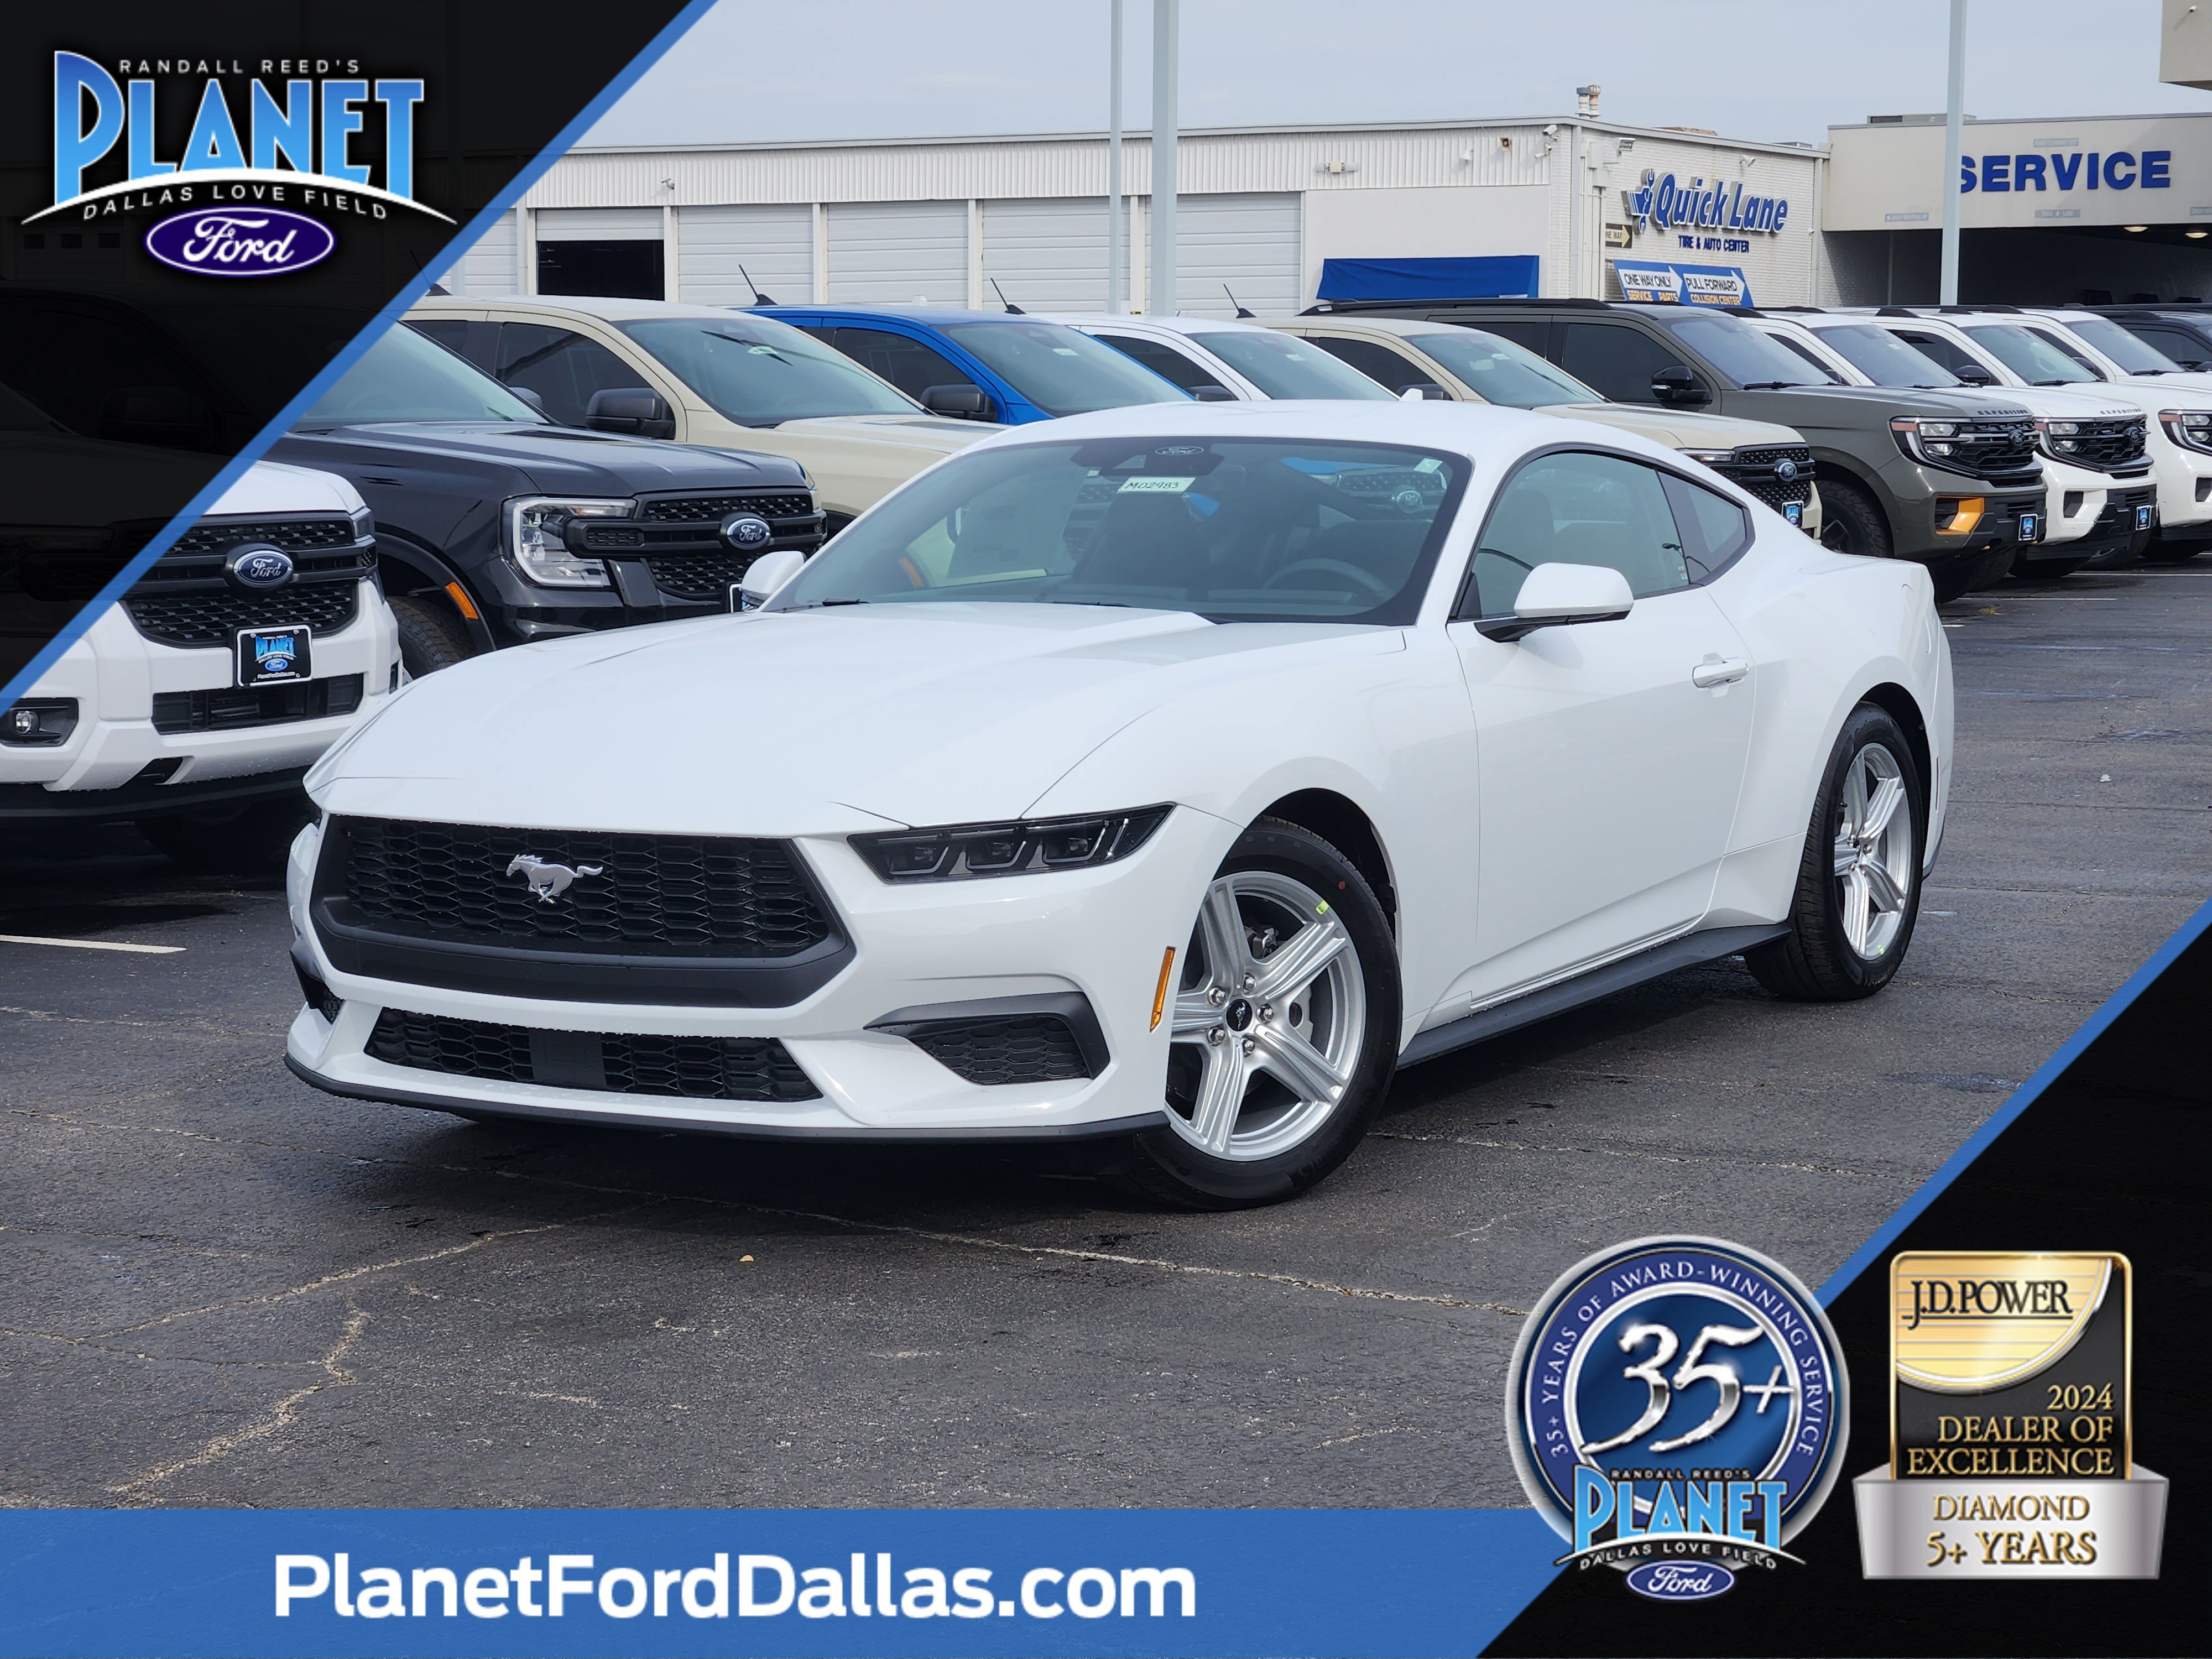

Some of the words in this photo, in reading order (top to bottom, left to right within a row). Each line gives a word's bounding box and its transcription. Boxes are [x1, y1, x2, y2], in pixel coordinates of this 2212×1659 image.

[1655, 172, 1730, 230] Quick
[1728, 181, 1789, 233] Lane
[1678, 234, 1694, 248] TIRE
[1696, 236, 1701, 249] &
[1703, 237, 1721, 251] AUTO
[1723, 238, 1749, 253] CENTER
[1624, 273, 1640, 285] ONE
[1638, 274, 1655, 286] WAY
[1654, 275, 1672, 288] ONLY
[1686, 278, 1705, 289] PULL
[1704, 278, 1738, 291] FORWARD
[1627, 290, 1653, 301] SERVICE
[1658, 291, 1679, 302] PARTS
[1691, 293, 1719, 304] COLLISION
[1719, 295, 1741, 305] CENTER
[739, 525, 762, 541] Ford
[251, 558, 281, 578] Ford
[255, 635, 294, 659] PLANET
